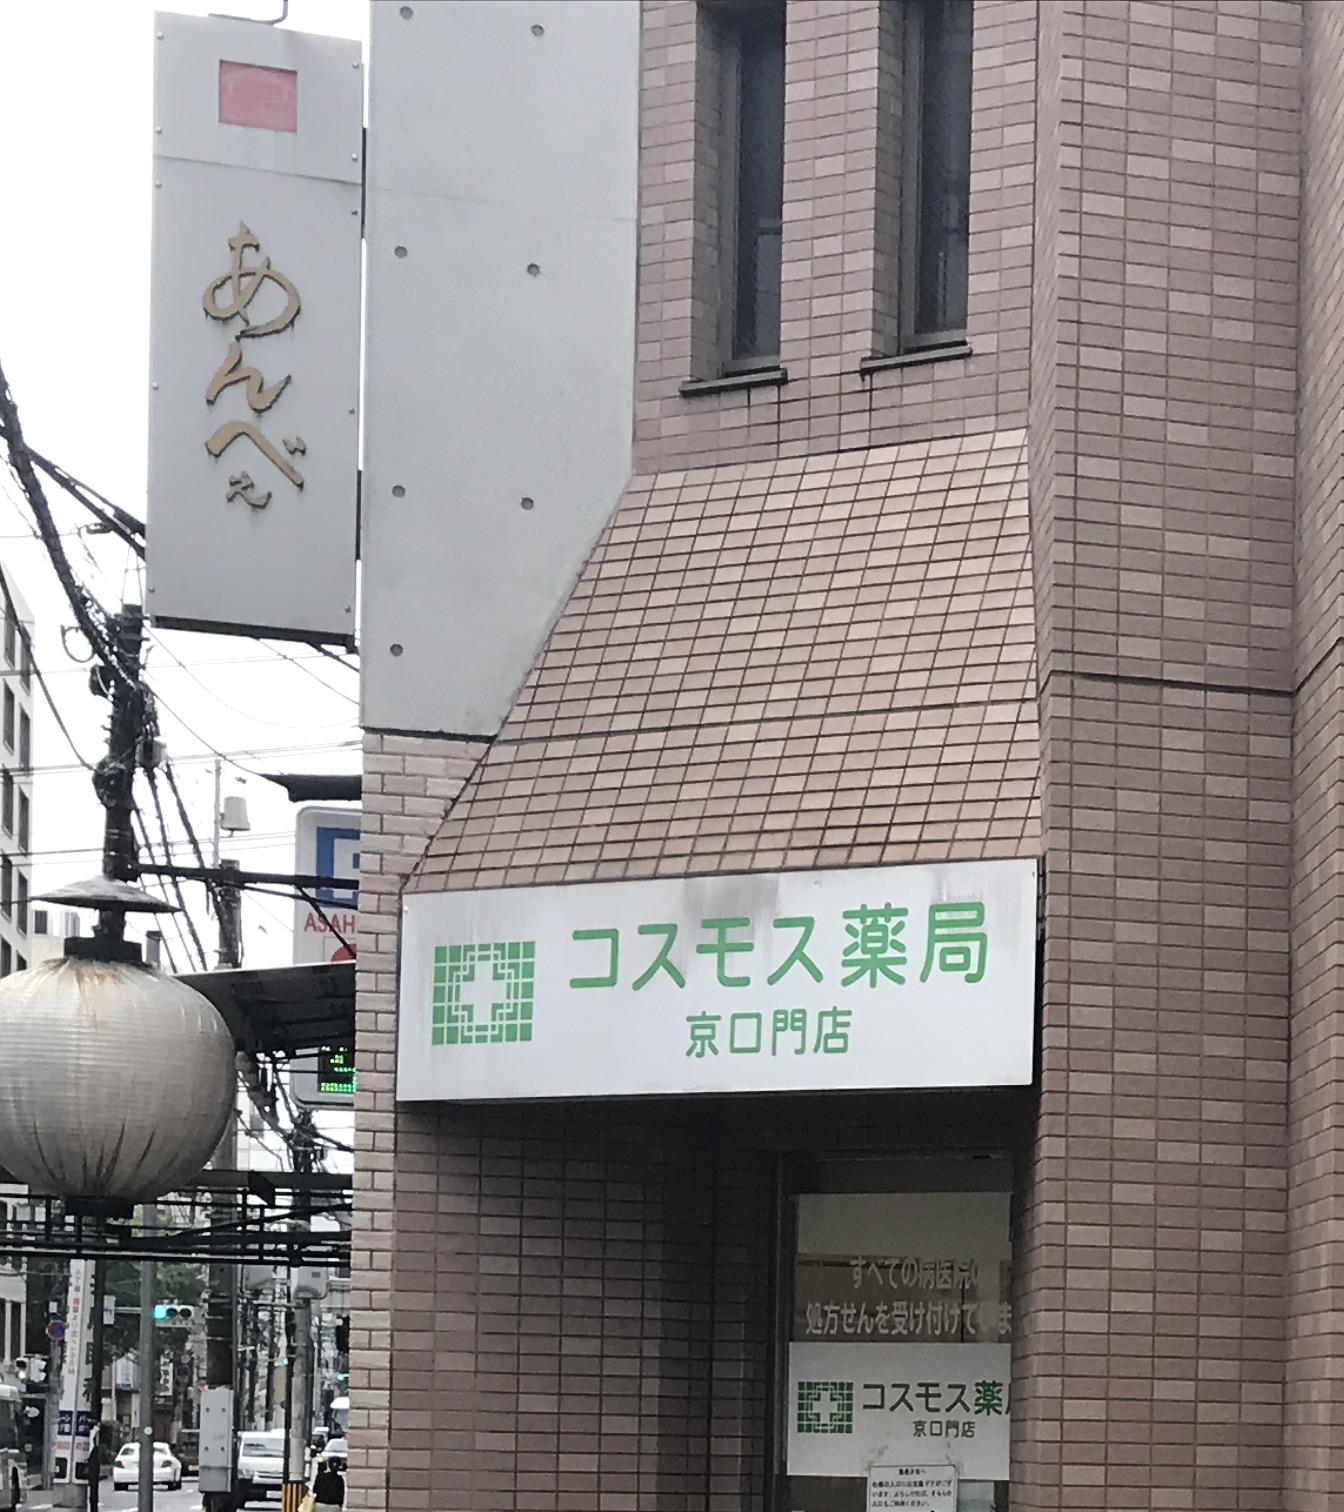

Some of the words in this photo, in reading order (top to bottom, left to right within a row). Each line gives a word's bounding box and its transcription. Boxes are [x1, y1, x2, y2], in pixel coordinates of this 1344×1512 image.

[568, 900, 989, 992] コスモス薬局
[685, 1005, 853, 1058] 京口門店
[862, 1380, 1011, 1417] コスモス薬
[912, 1419, 976, 1439] 京口門店
